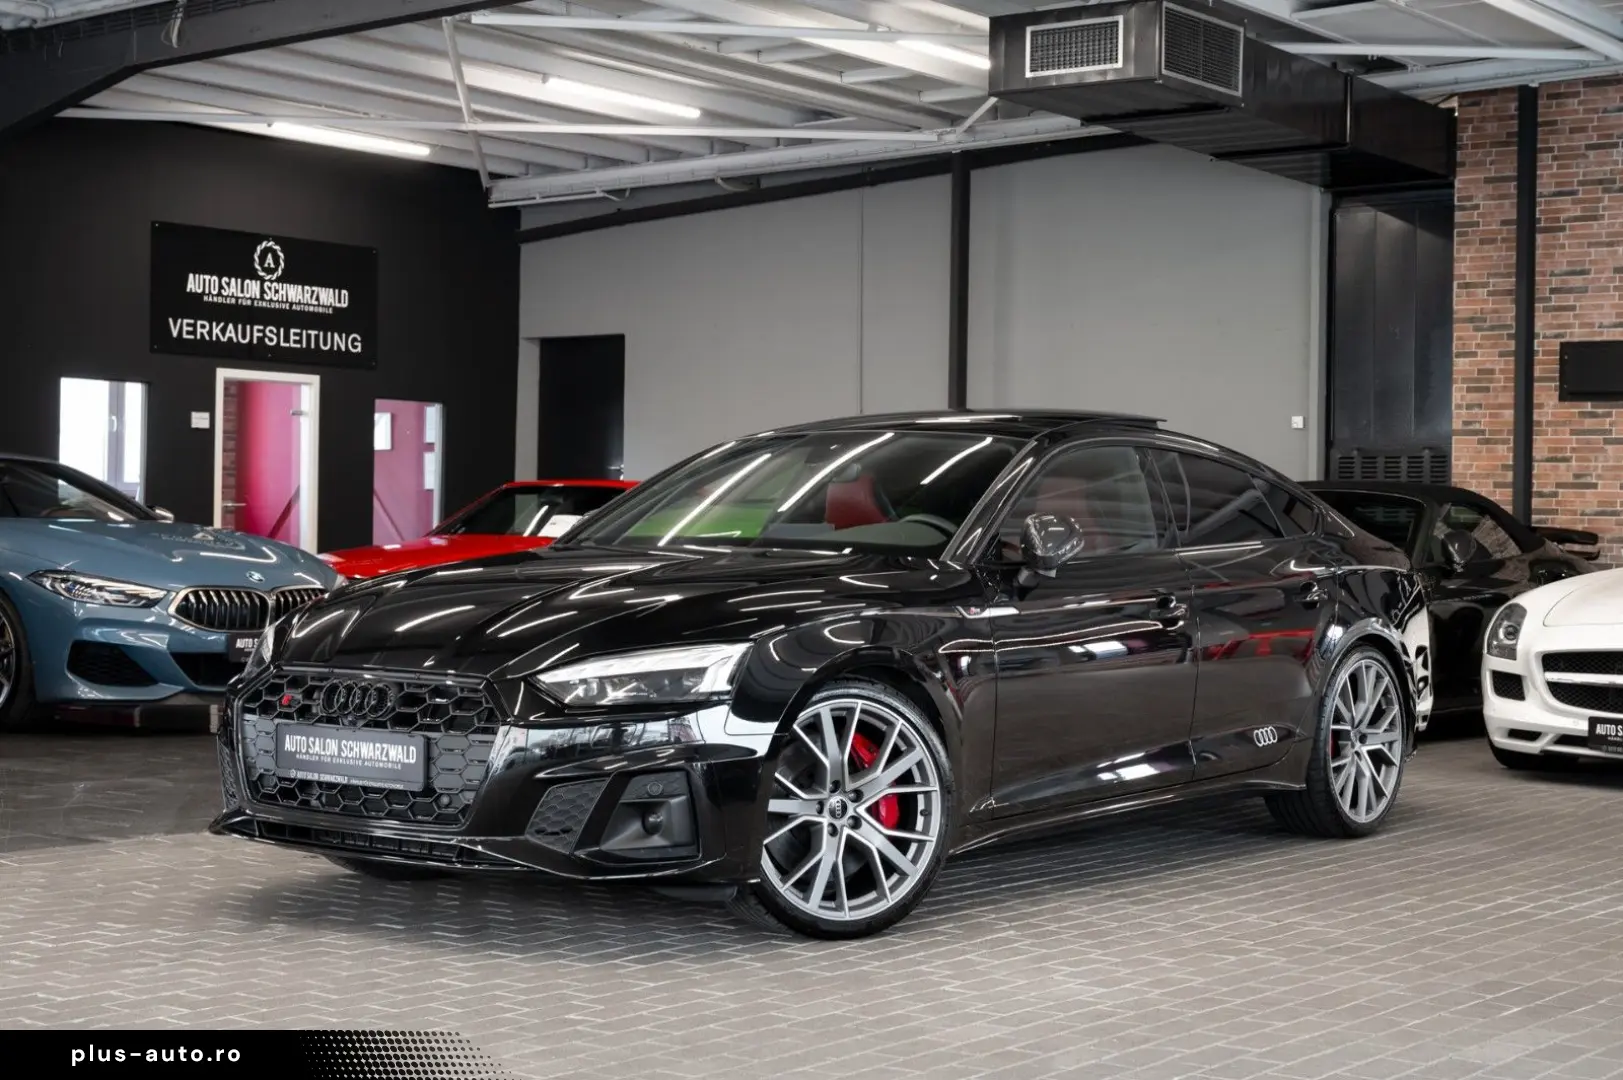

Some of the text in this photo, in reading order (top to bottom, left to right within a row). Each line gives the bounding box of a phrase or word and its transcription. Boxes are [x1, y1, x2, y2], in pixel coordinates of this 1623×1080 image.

[263, 252, 275, 268] A
[186, 273, 349, 308] AUTO SALON SCHWARZWALD
[203, 294, 235, 304] HÄNDLER
[254, 300, 290, 310] EXKLUSIVE
[292, 303, 333, 314] AUTOMOBILE
[168, 317, 362, 353] VERKAUFSLEITUNG
[235, 638, 253, 648] AUTO
[1595, 723, 1623, 736] AUTO S
[284, 734, 417, 763] AUTO SALON SCHWARZWALD
